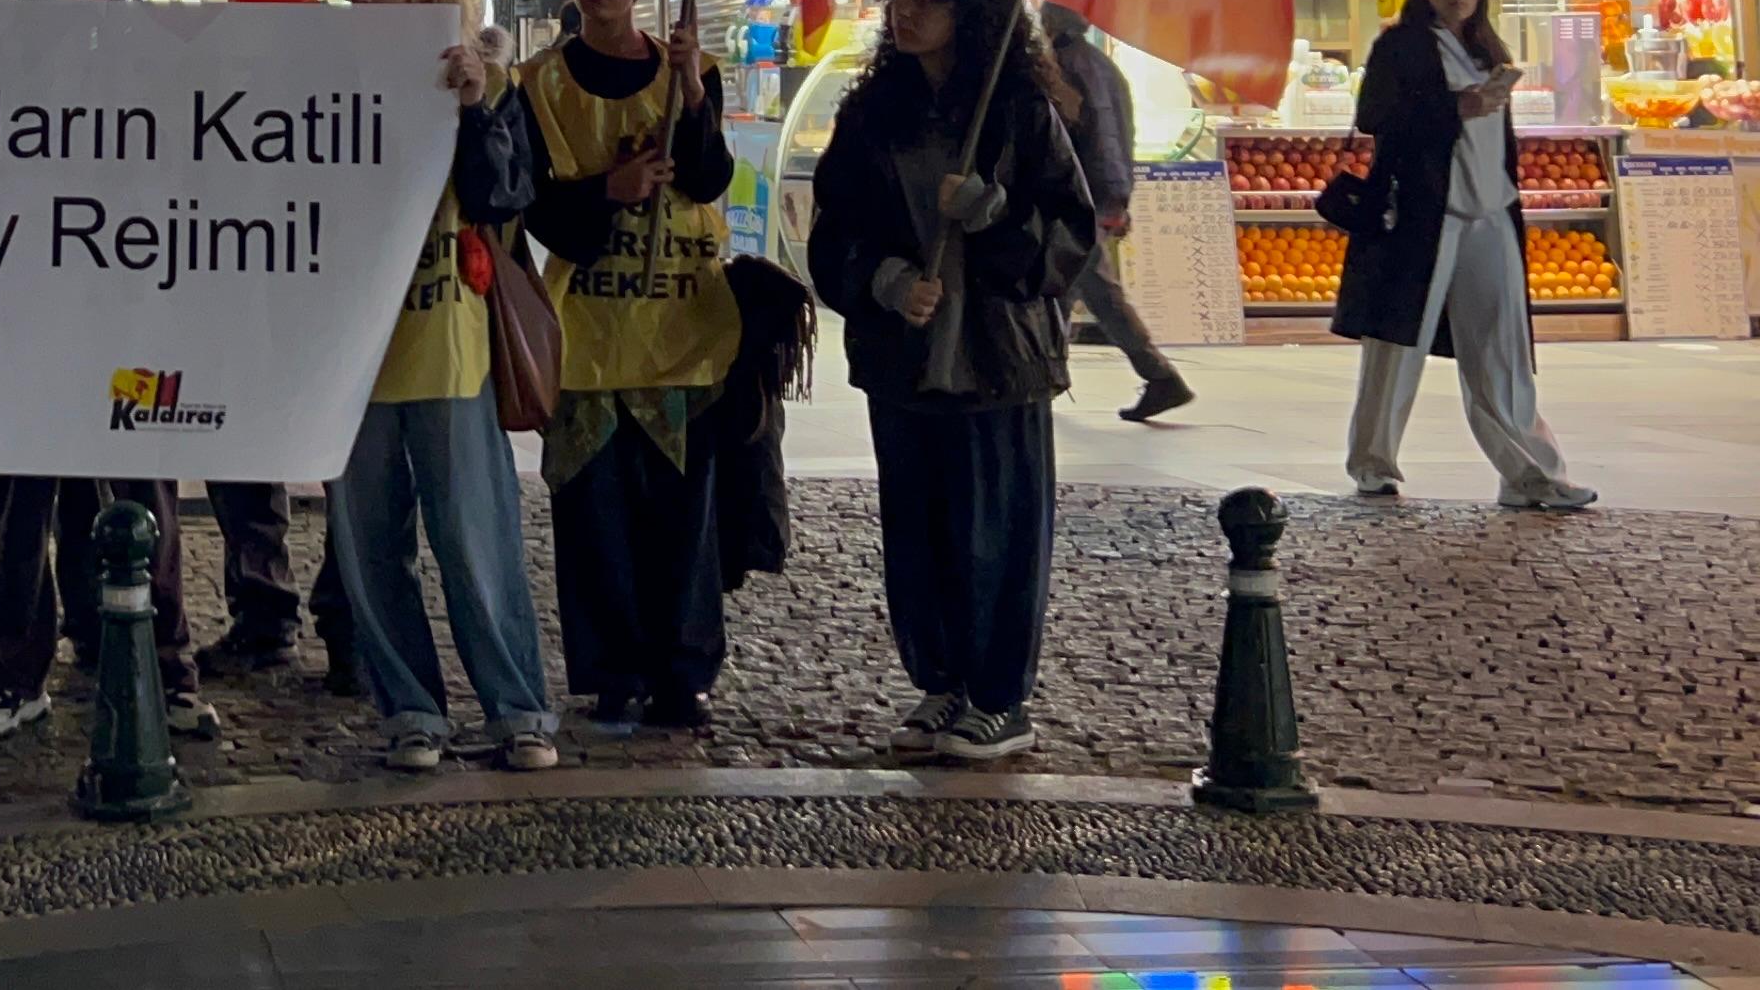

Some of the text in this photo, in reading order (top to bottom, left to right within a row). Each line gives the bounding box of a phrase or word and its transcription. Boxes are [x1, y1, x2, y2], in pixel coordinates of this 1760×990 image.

[192, 89, 384, 166] Katili
[50, 195, 323, 291] Rejimi!
[109, 369, 227, 431] Kaldıraç
